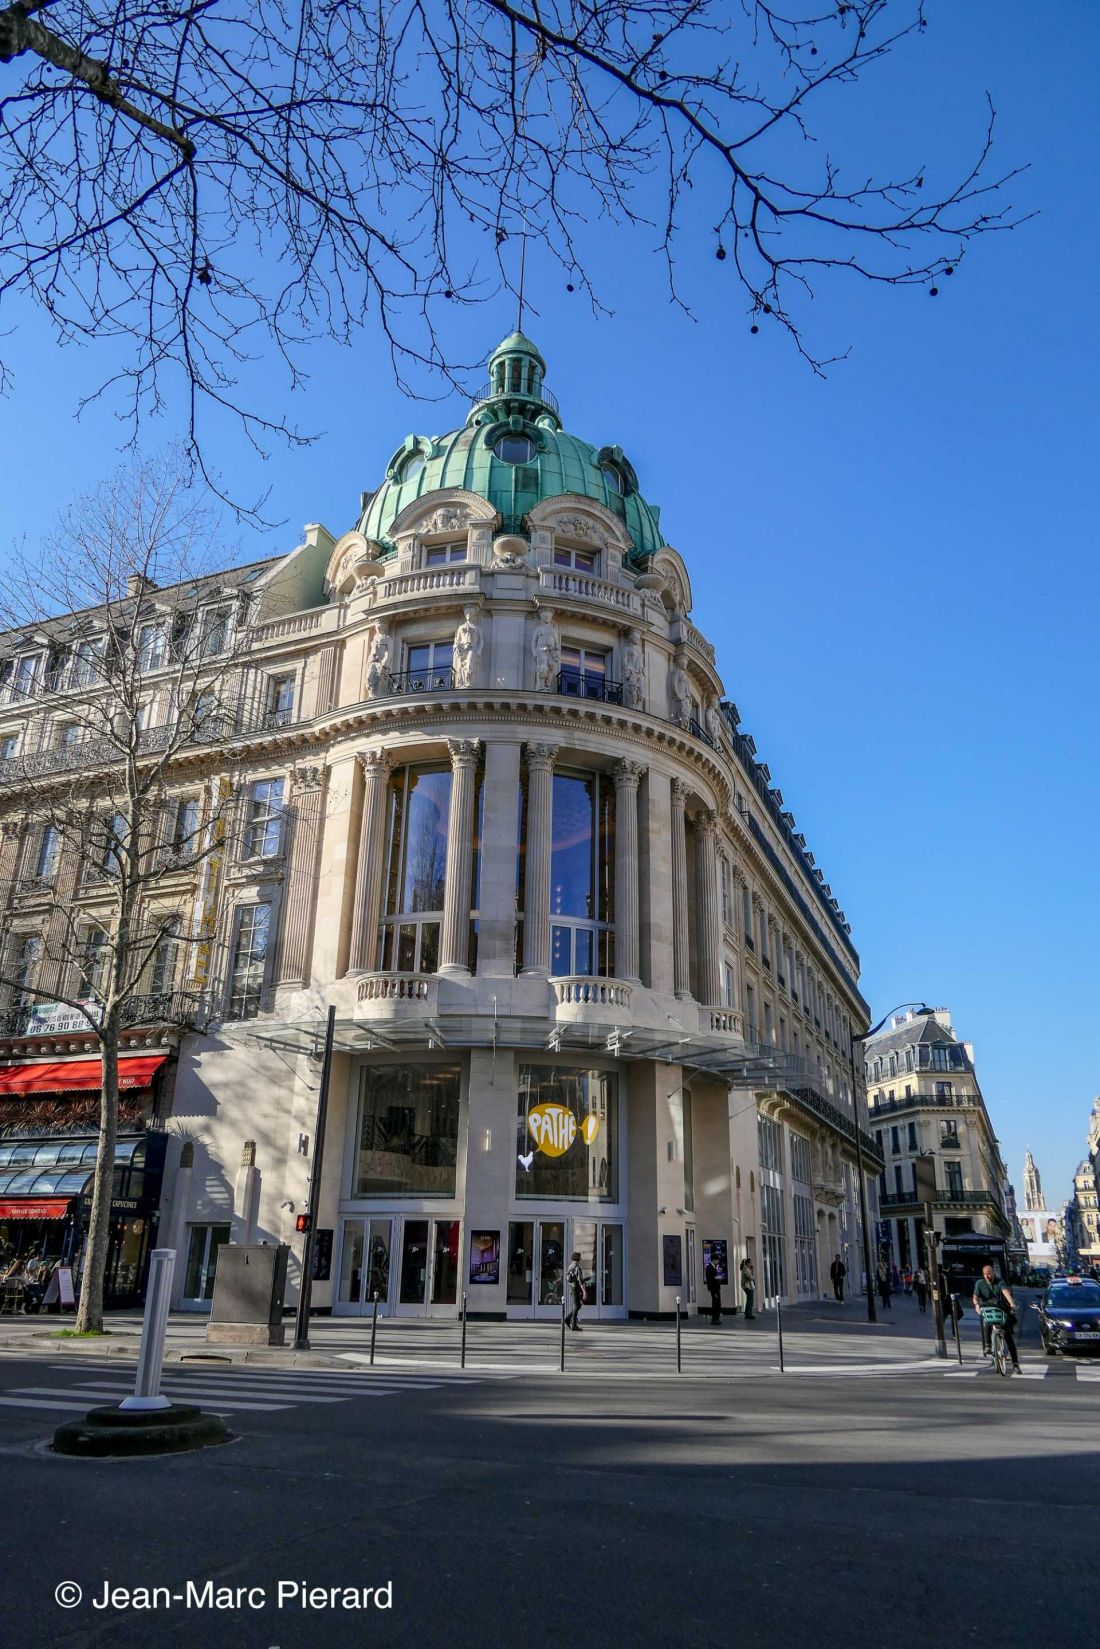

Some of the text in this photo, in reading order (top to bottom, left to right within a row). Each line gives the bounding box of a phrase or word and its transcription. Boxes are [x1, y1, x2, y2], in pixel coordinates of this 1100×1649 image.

[30, 1024, 42, 1033] 06
[44, 1023, 55, 1032] 76
[57, 1022, 69, 1031] 90
